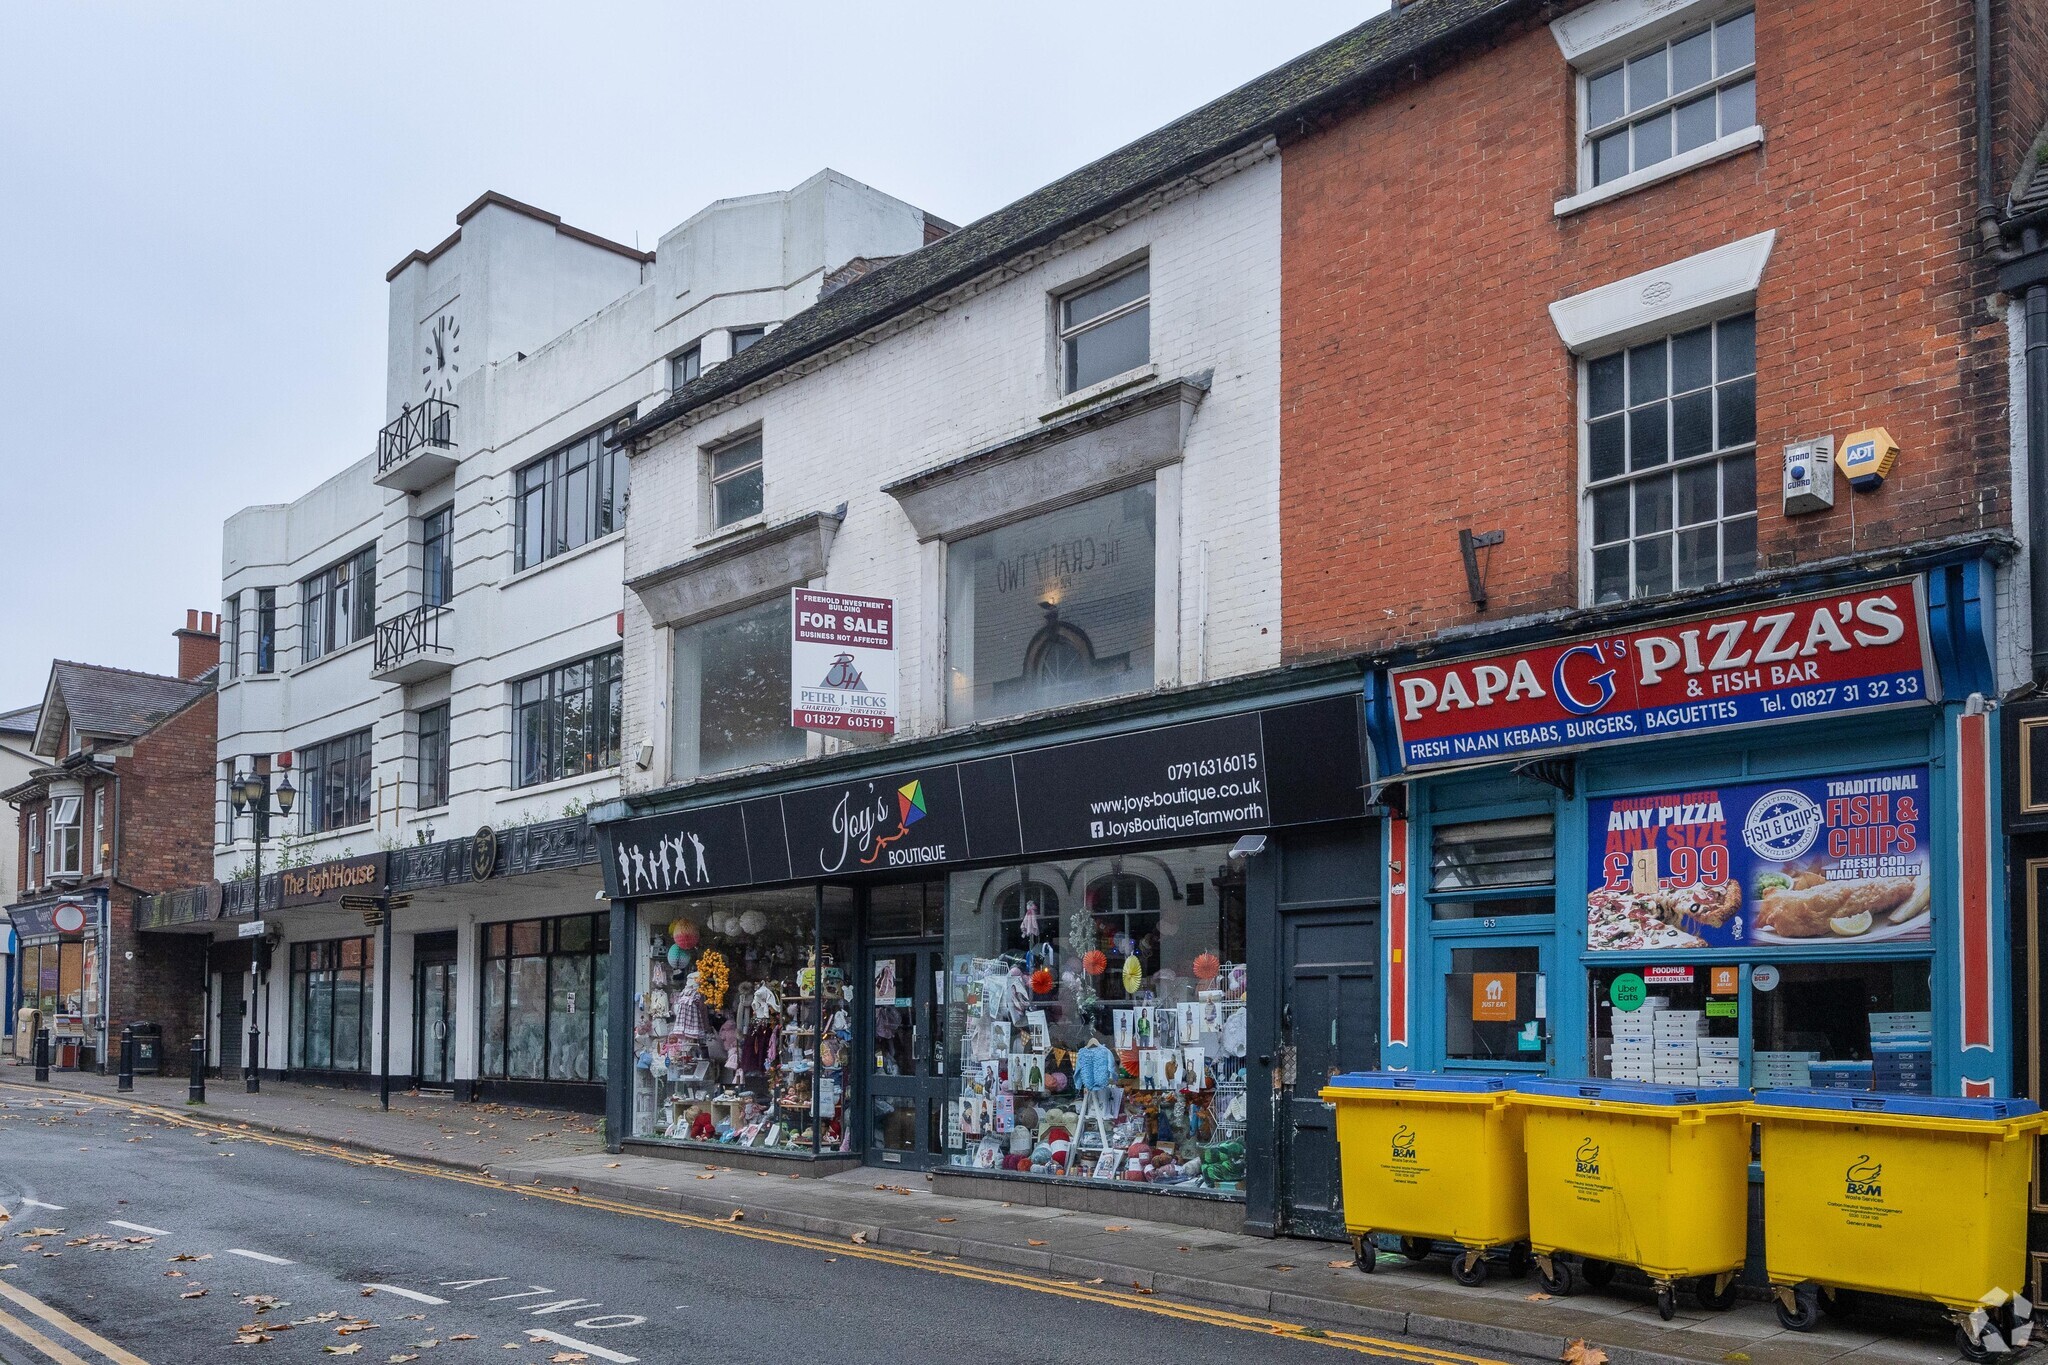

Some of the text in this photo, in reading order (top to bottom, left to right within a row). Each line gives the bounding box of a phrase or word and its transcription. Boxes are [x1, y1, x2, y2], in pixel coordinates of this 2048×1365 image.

[1788, 452, 1810, 463] STAND
[1847, 444, 1874, 462] ADT
[1787, 478, 1811, 490] GUARD
[803, 595, 885, 610] FREEHOLD INVESTMENT
[828, 604, 861, 613] BUILDING
[800, 612, 888, 635] FOR SALE
[800, 630, 835, 640] BUSINESS
[853, 636, 888, 645] AFFECTED
[1399, 658, 1547, 723] PAPA
[1635, 595, 1905, 688] PIZZA'S
[1686, 660, 1821, 698] & FISH BAR
[801, 691, 887, 708] PETER J. HICKS
[801, 704, 841, 712] CHARTERED
[804, 713, 884, 729] 01827 60519
[1410, 676, 1919, 759] FRESH NAAN KEBABS, BURGERS, BAGUETTES Tel. 01827 31 32 33
[1166, 753, 1259, 782] 07916316015
[1090, 778, 1262, 815] www.joys-boutique.co.uk
[1827, 774, 1919, 797] TRADITIONAL
[1613, 790, 1719, 812] COLLECTION OFFER
[1752, 795, 1803, 824] TRADITIONAL
[1826, 794, 1919, 828] FISH &
[819, 782, 890, 873] Joy's
[1106, 803, 1264, 837] JoysBoutiqueTamworth
[1607, 801, 1725, 832] ANY PIZZA
[1744, 806, 1822, 845] FISH & CHIPS
[1605, 820, 1728, 855] ANY SIZE
[1758, 825, 1814, 857] ENGLISH FOOD
[1828, 823, 1917, 859] CHIPS
[888, 843, 947, 867] BOUTIQUE
[1839, 855, 1906, 870] FRESH COD
[1825, 864, 1922, 880] MADE TO ORDER
[283, 872, 305, 896] The
[1483, 919, 1496, 928] 63
[1652, 966, 1686, 974] FOODHUB
[1617, 984, 1638, 993] Uber
[1618, 993, 1638, 1001] Eats
[1393, 1149, 1415, 1158] B&M
[1576, 1162, 1599, 1174] B&M
[1847, 1183, 1882, 1197] B&M
